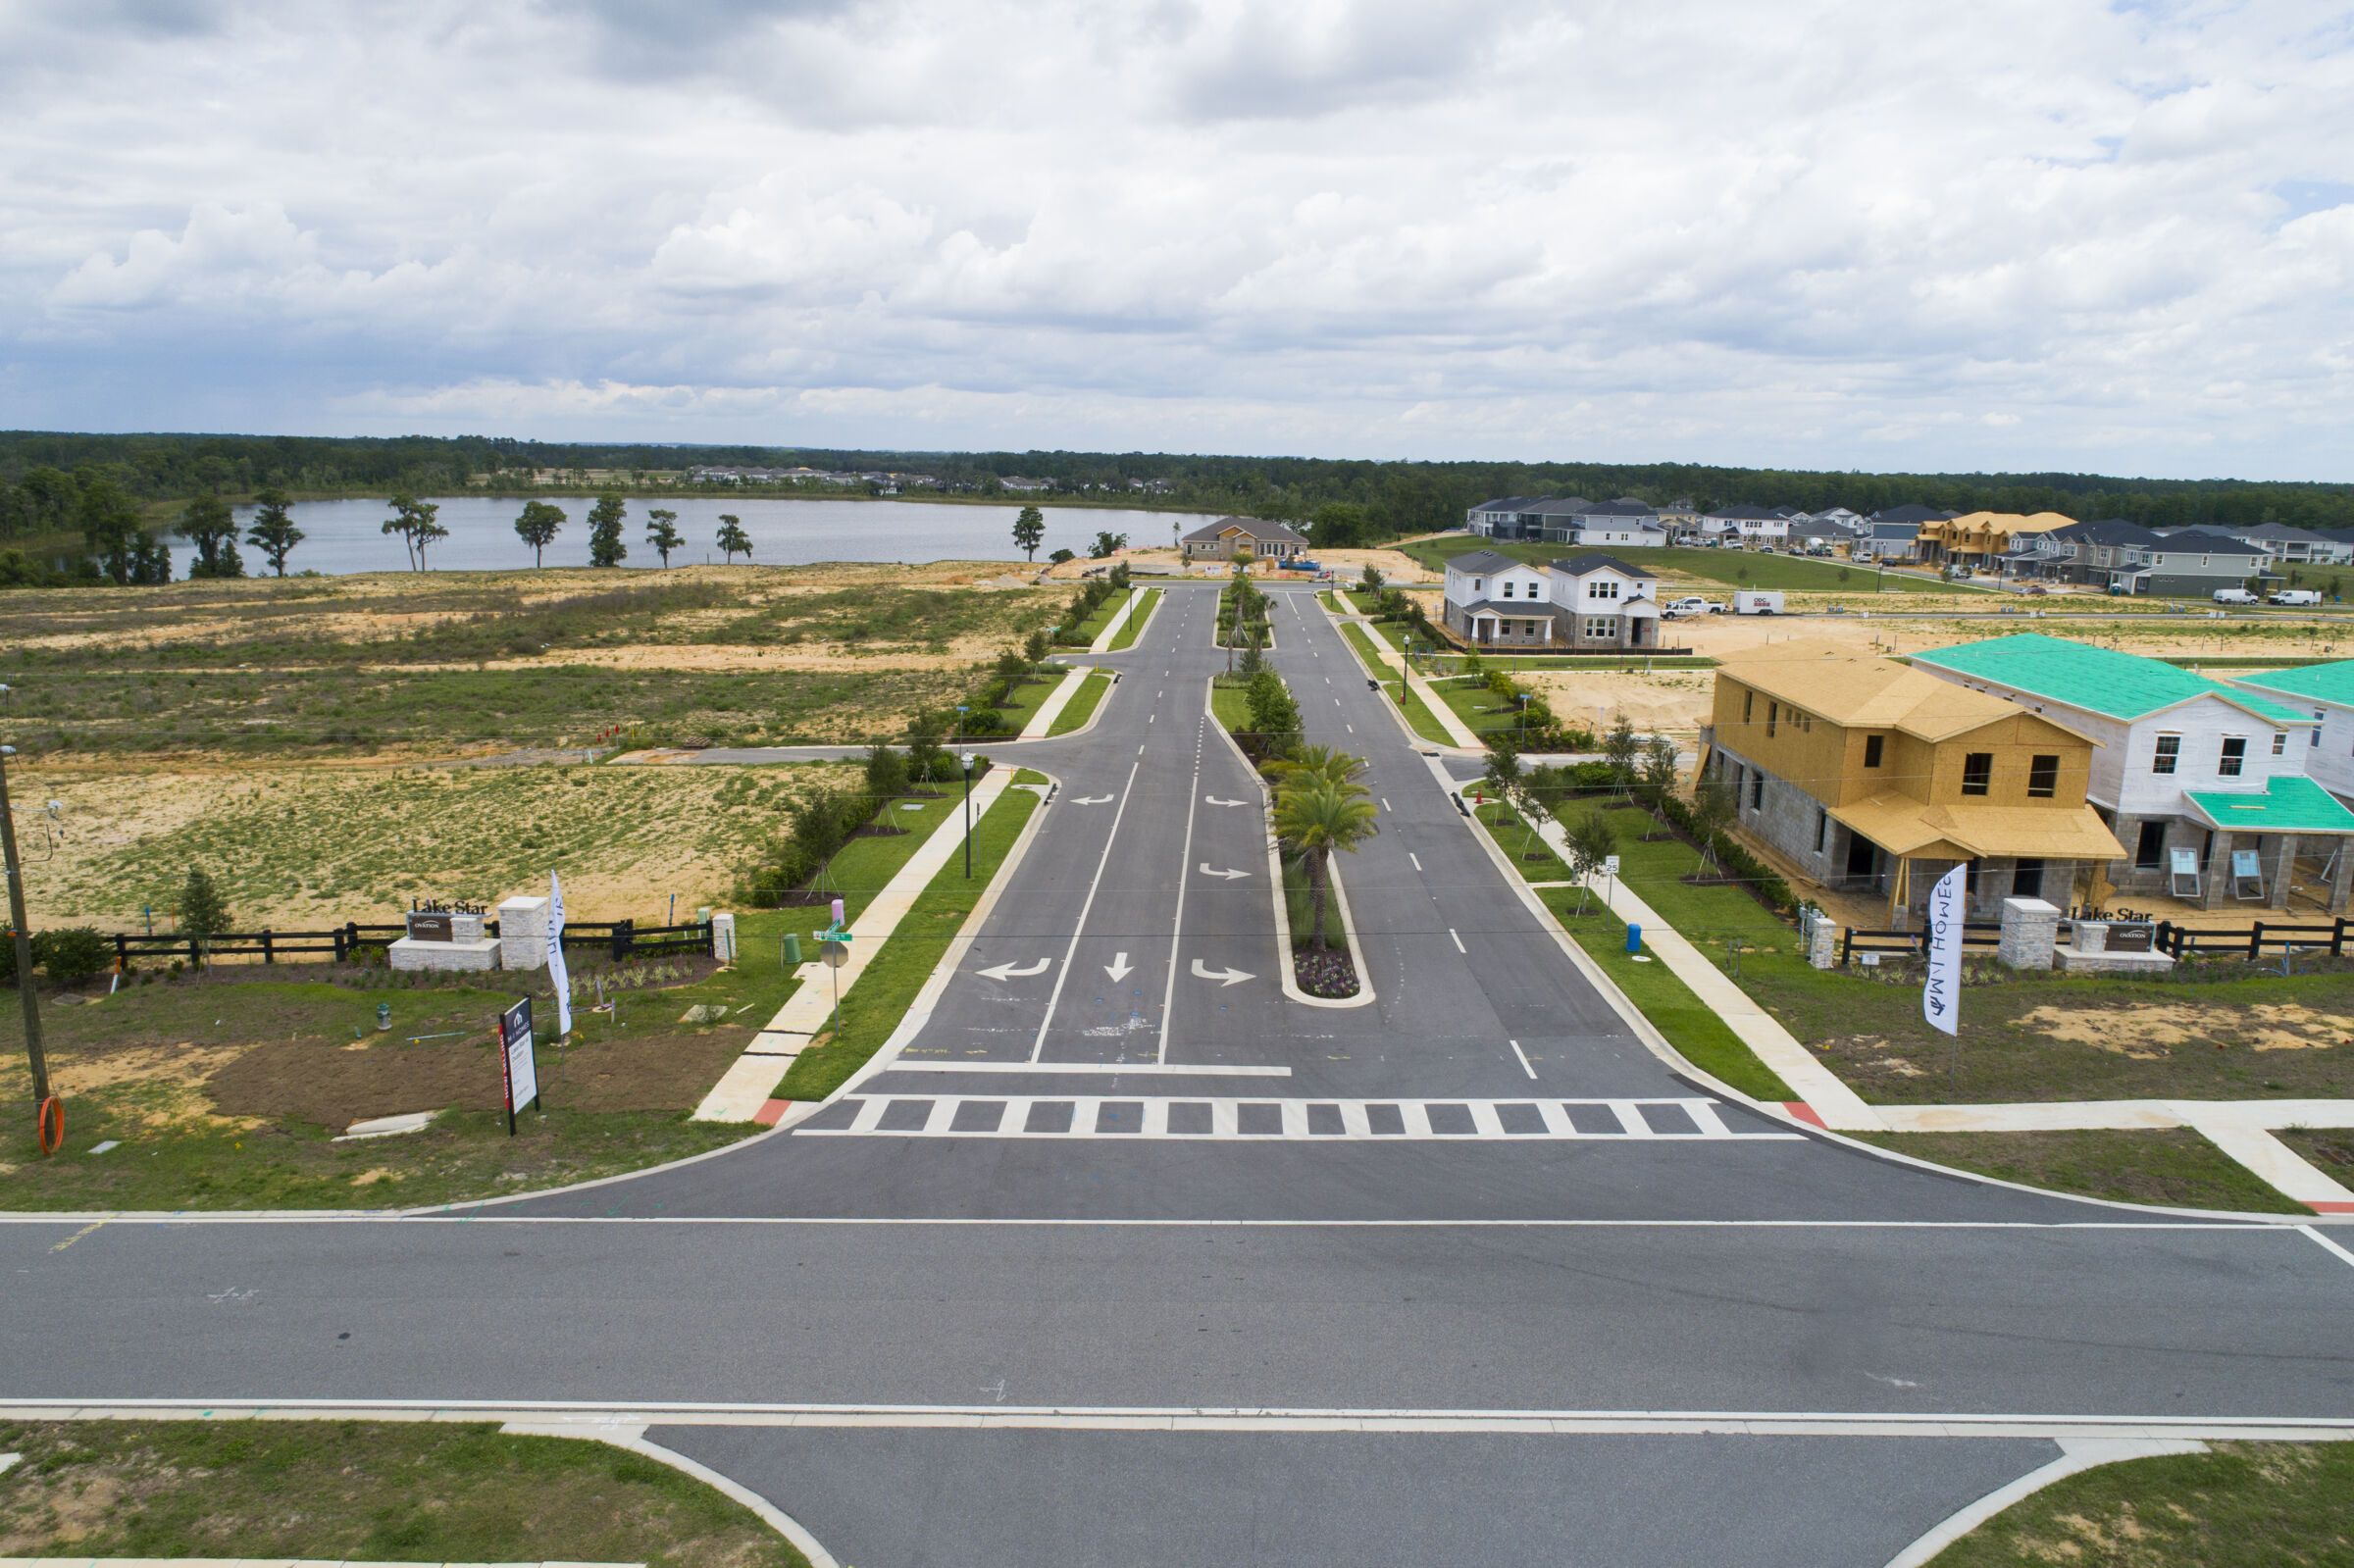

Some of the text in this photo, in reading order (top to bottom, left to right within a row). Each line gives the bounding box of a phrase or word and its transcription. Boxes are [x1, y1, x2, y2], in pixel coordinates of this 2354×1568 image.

[412, 899, 488, 915] Lake Star
[2071, 906, 2153, 922] Lake Star
